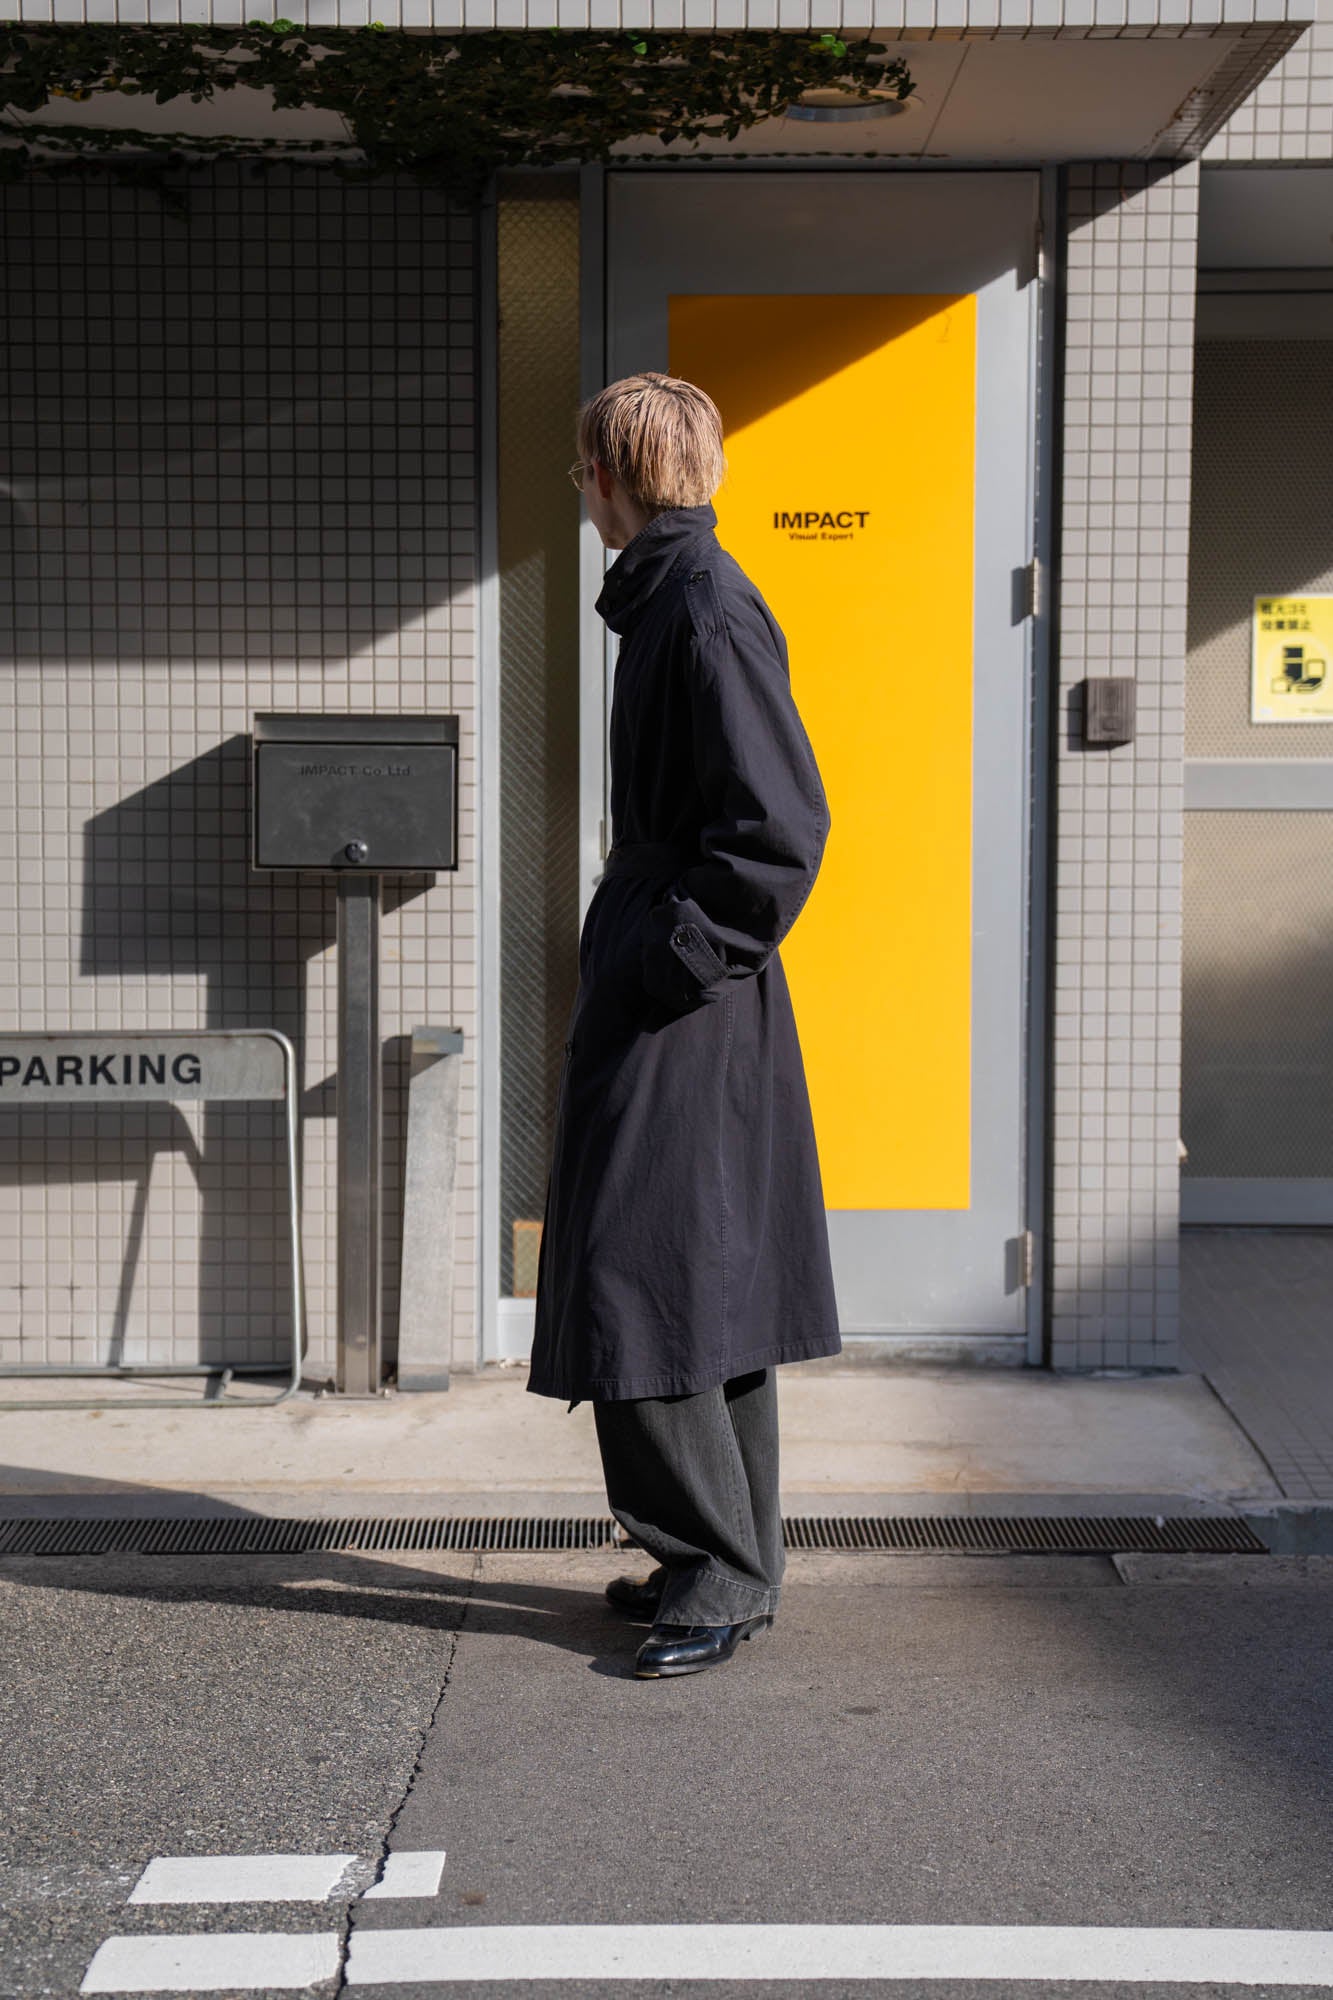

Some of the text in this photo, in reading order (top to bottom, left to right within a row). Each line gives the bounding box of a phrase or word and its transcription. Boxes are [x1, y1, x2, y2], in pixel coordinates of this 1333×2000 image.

[773, 511, 870, 529] IMPACT
[788, 532, 854, 541] Visual Expert
[300, 765, 356, 777] IMPACT
[0, 1053, 202, 1087] PARKING
